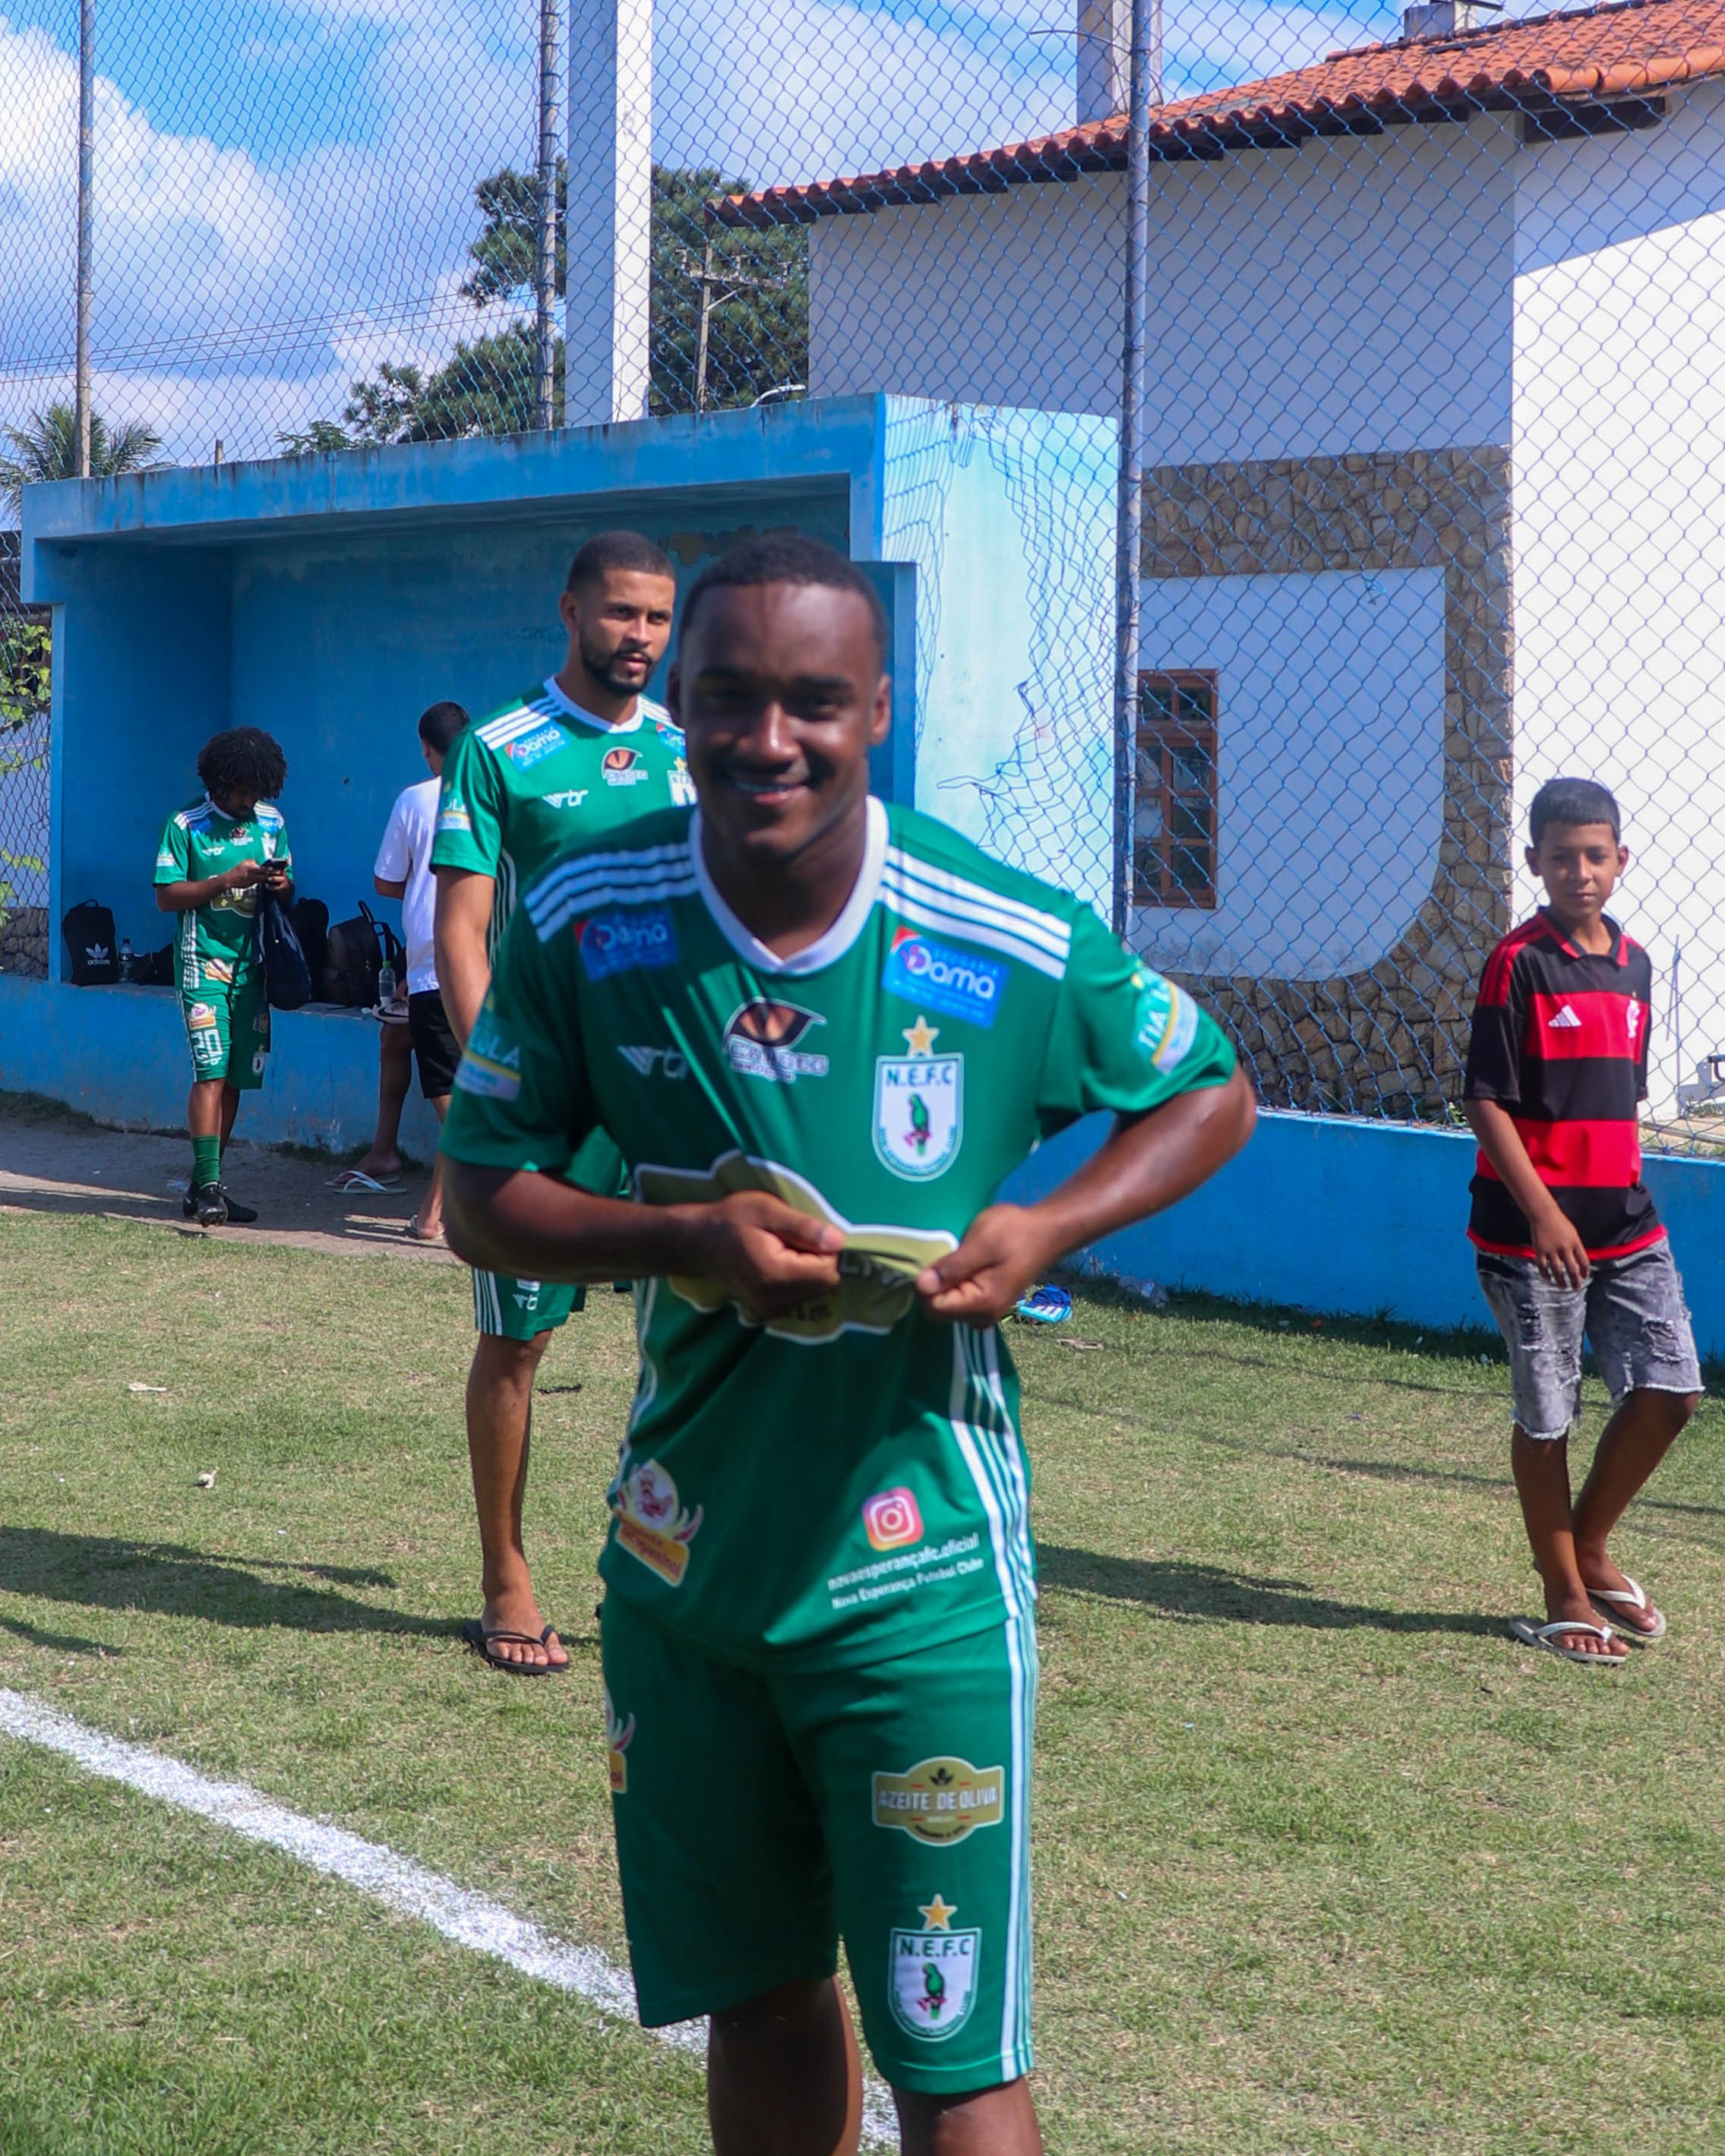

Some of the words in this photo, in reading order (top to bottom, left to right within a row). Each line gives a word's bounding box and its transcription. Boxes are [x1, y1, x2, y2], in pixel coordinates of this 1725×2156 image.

[878, 1790, 932, 1810] AZEITE
[937, 1791, 958, 1810] DE
[959, 1786, 998, 1809] OLIVA
[899, 1937, 971, 1957] N.E.F.C
